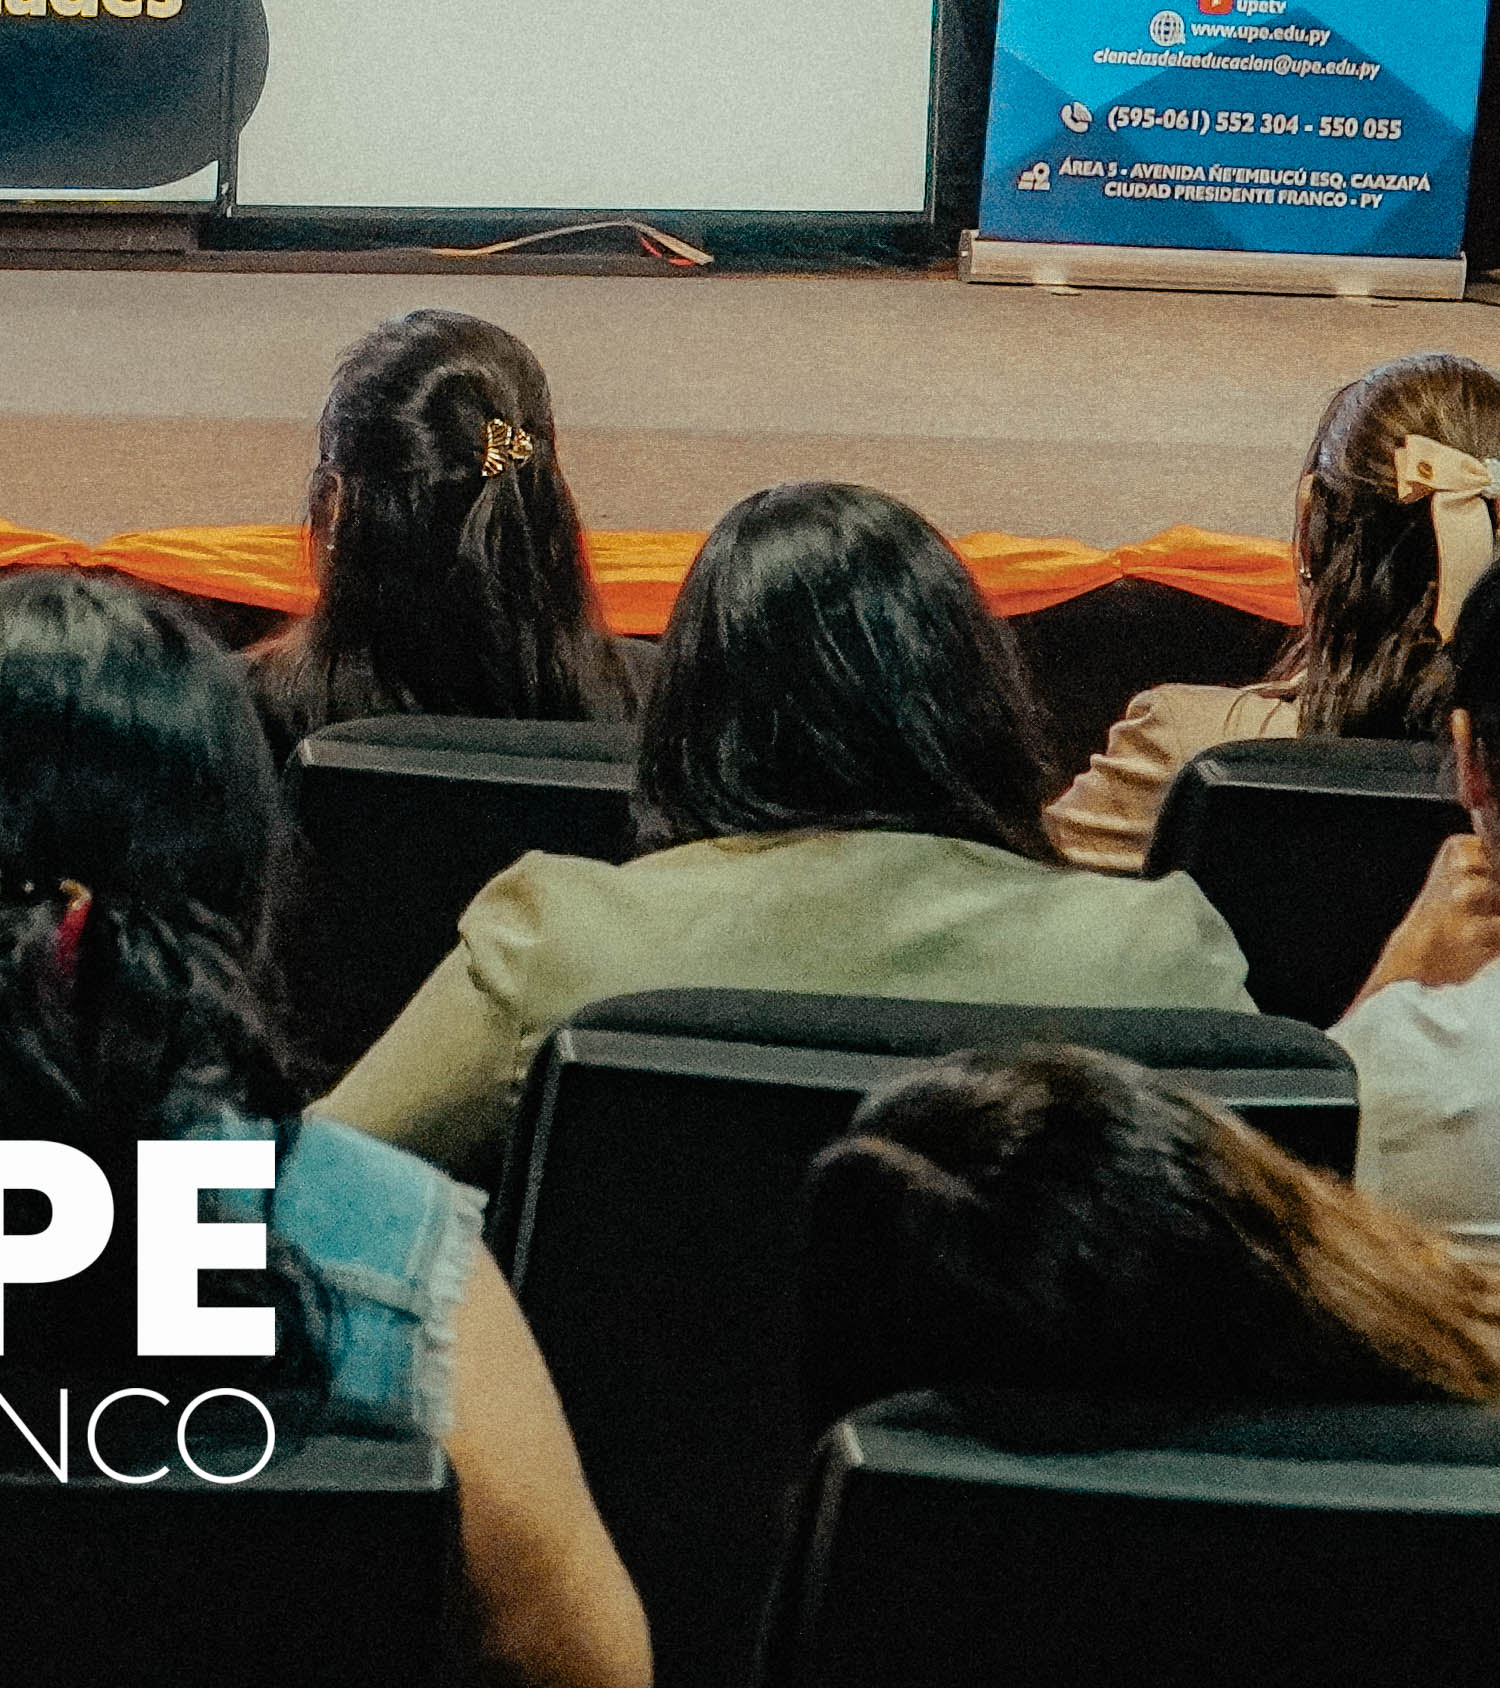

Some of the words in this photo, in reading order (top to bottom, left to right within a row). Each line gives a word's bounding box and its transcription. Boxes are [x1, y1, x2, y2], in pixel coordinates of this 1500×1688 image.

[1236, 0, 1287, 16] upetv
[1190, 22, 1331, 46] www.upe.edu.py
[1093, 47, 1380, 81] cienciasdelaeducacion@upe.edu.py
[1107, 105, 1210, 135] (595-061)
[1215, 112, 1254, 133] 552
[1260, 113, 1298, 135] 304
[1318, 116, 1356, 138] 550
[1362, 117, 1402, 140] 055
[1058, 155, 1104, 176] ÁREA
[1129, 161, 1206, 182] AVENIDA
[1310, 169, 1347, 189] ESQ.
[1350, 171, 1431, 192] CAAZAPÁ
[1104, 181, 1171, 199] CIUDAD
[1173, 184, 1274, 204] PRESIDENTE
[1277, 189, 1347, 207] FRANCO
[1360, 193, 1383, 209] PY
